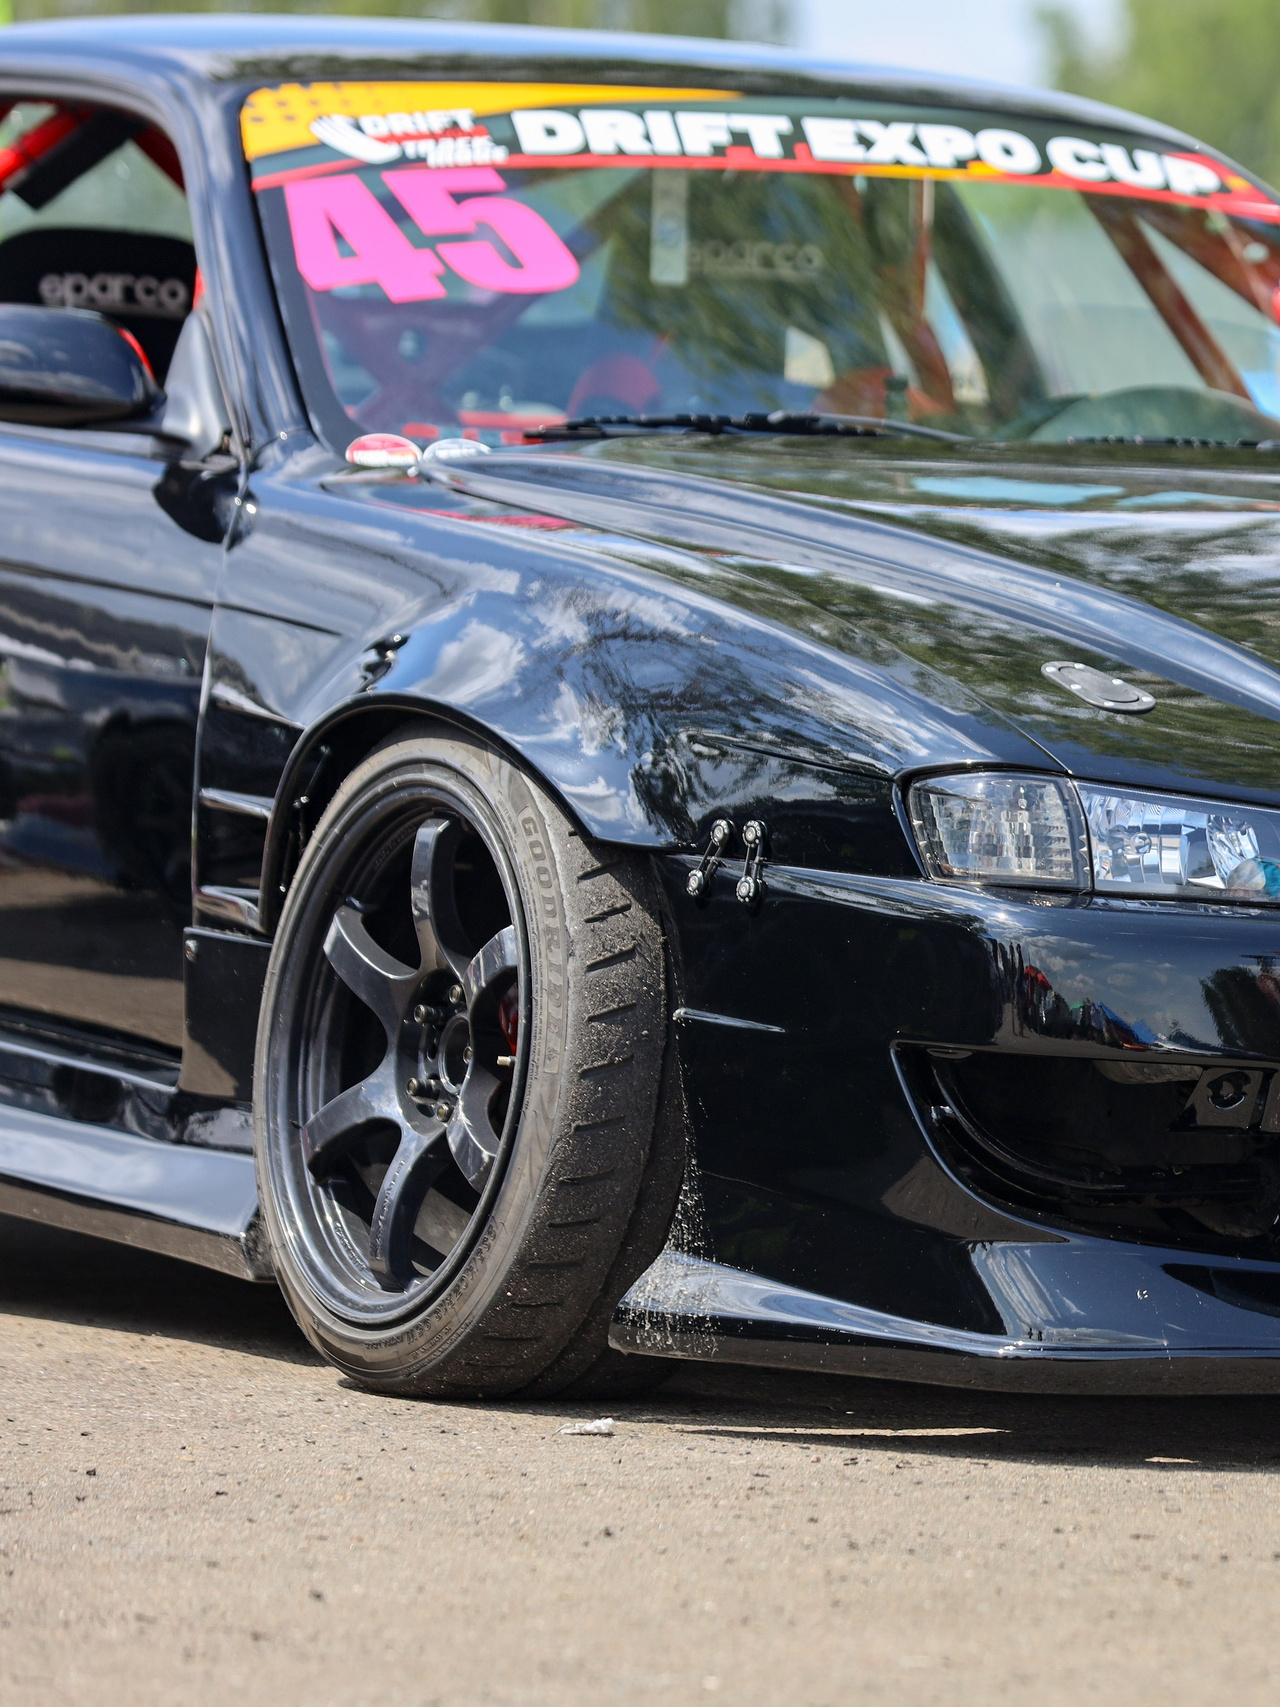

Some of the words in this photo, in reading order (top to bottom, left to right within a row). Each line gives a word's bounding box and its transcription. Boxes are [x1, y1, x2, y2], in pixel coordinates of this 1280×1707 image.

[359, 108, 475, 138] DRIFT
[510, 109, 793, 159] DRIFT
[800, 116, 1041, 175] EXPO
[1046, 136, 1222, 197] CUP
[283, 166, 580, 303] 45
[521, 816, 563, 1038] GOODRIDE
